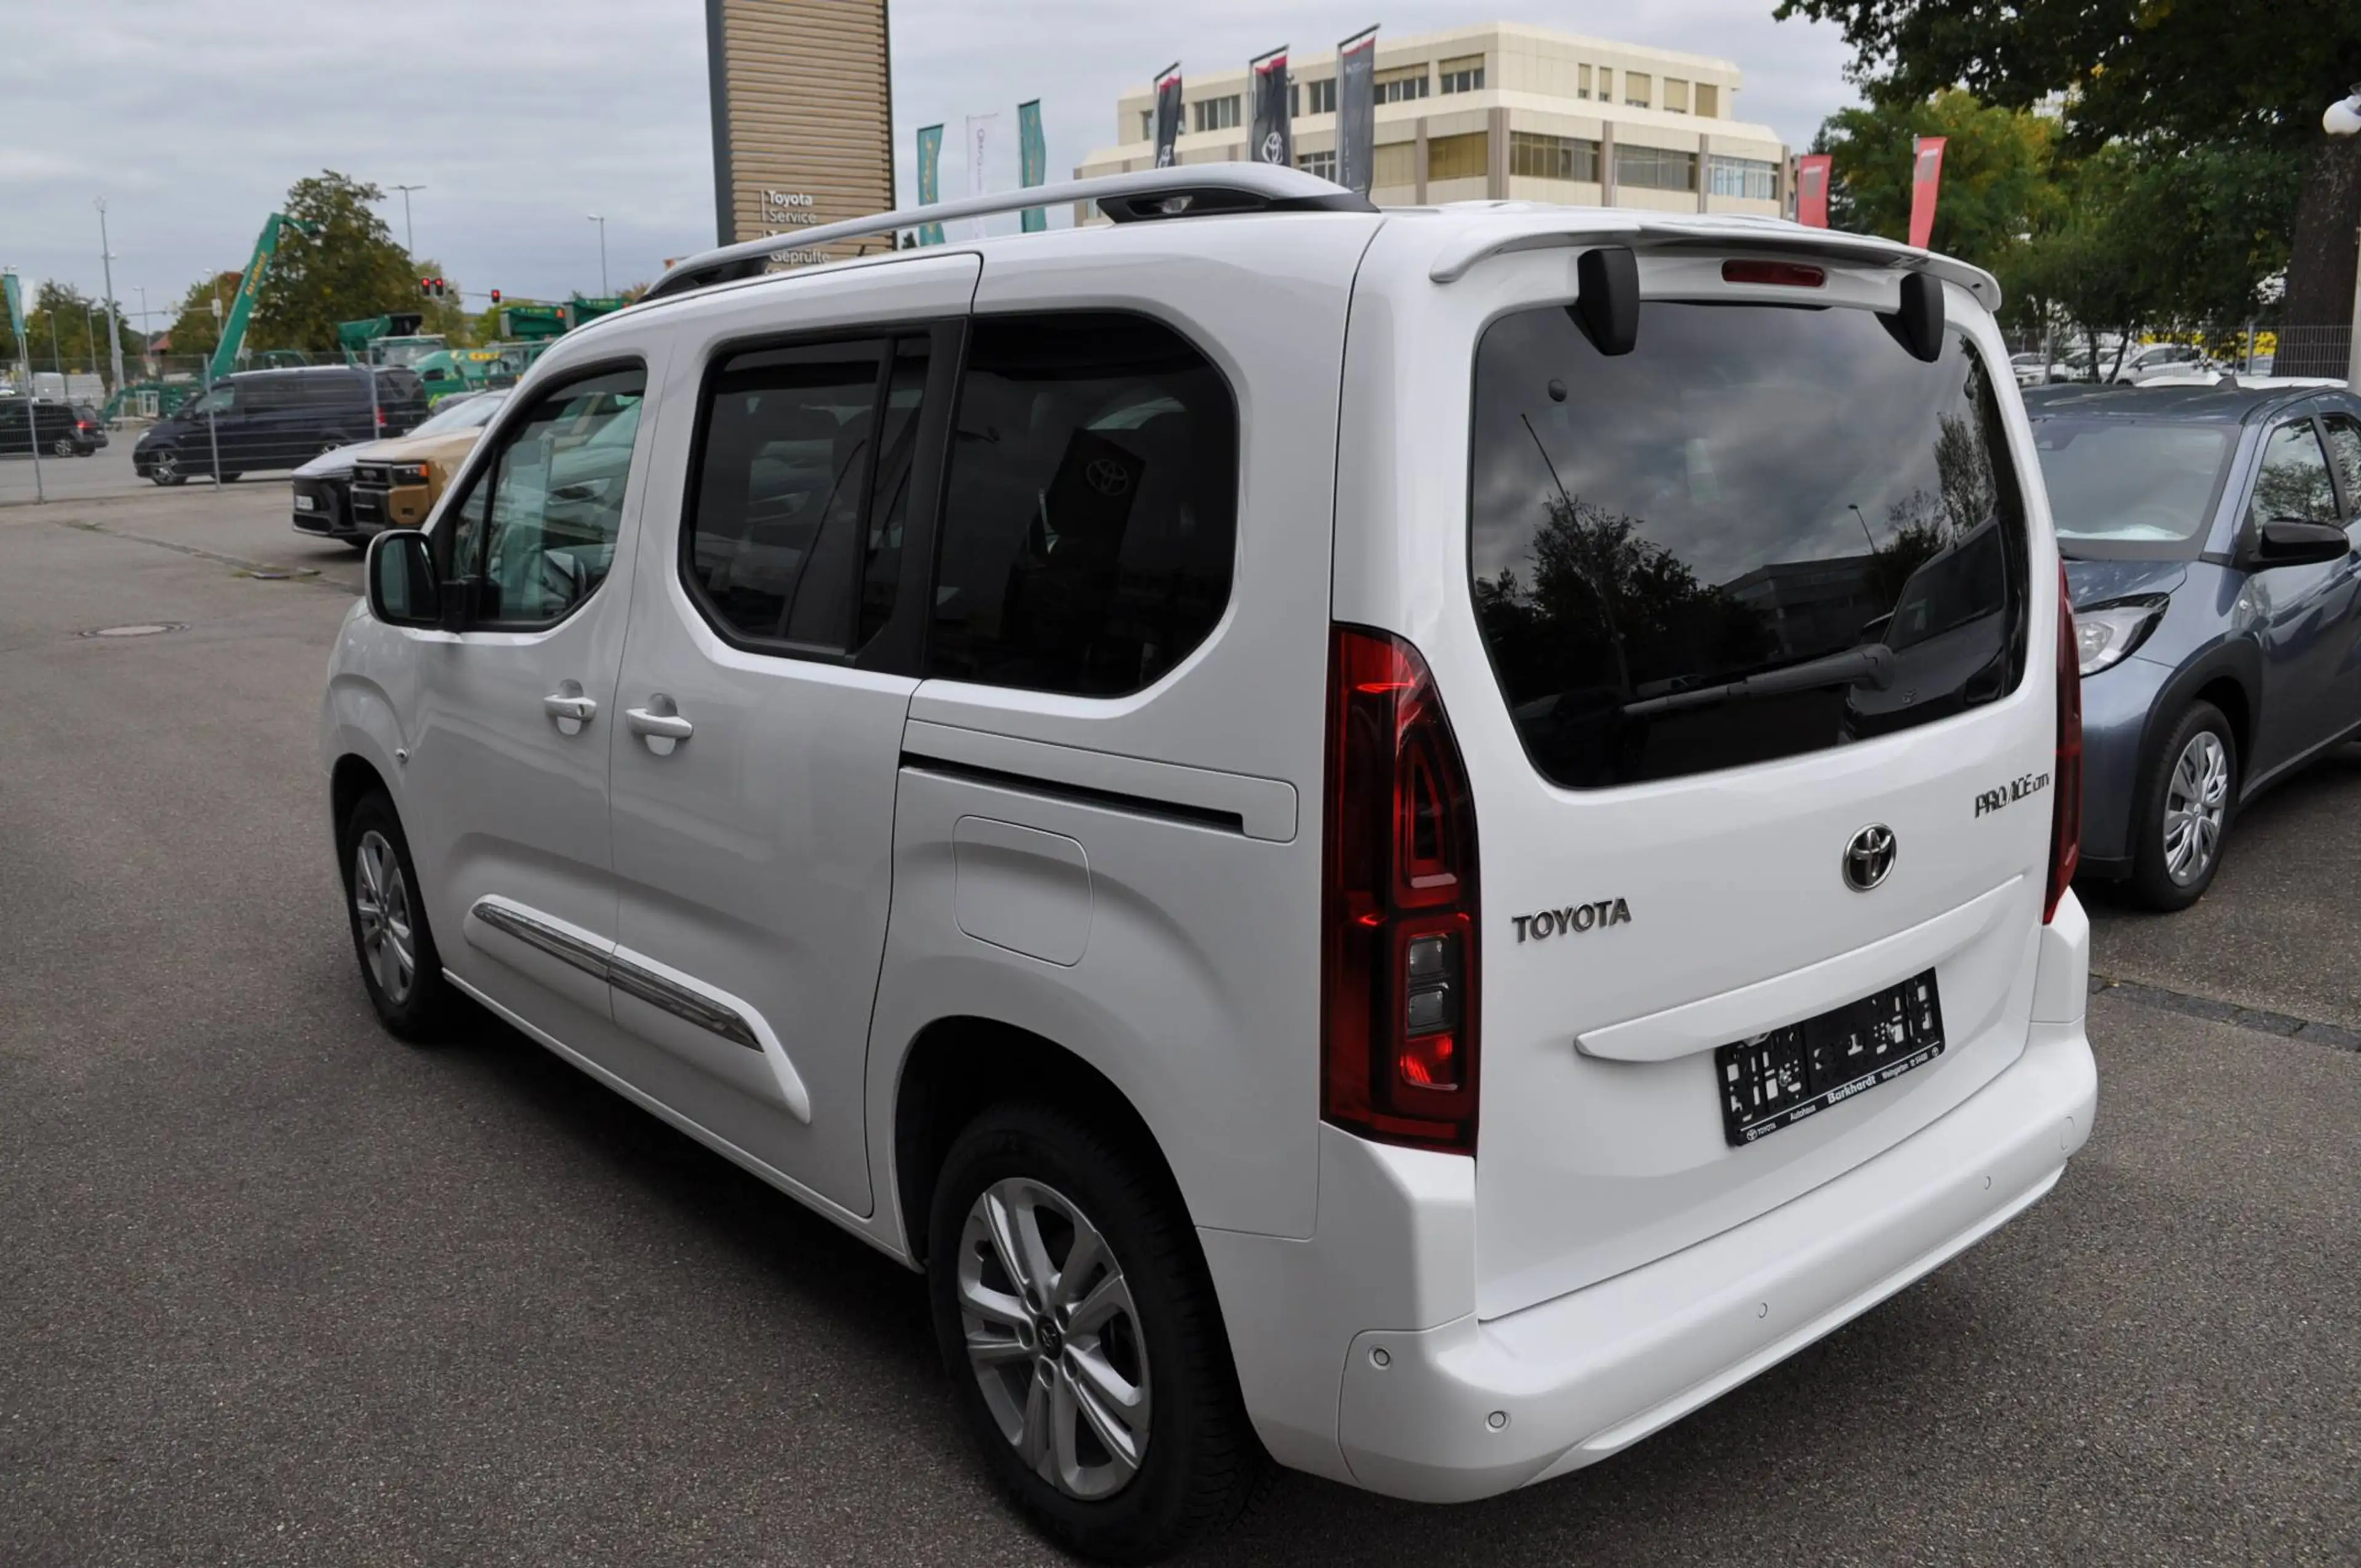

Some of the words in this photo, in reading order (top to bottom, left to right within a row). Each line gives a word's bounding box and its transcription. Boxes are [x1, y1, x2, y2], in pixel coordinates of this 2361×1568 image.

[768, 190, 812, 208] Toyota
[769, 208, 817, 224] Service
[1975, 773, 2031, 818] PROACE
[1511, 897, 1632, 944] TOYOTA
[1757, 1122, 1777, 1135] TOYOTA
